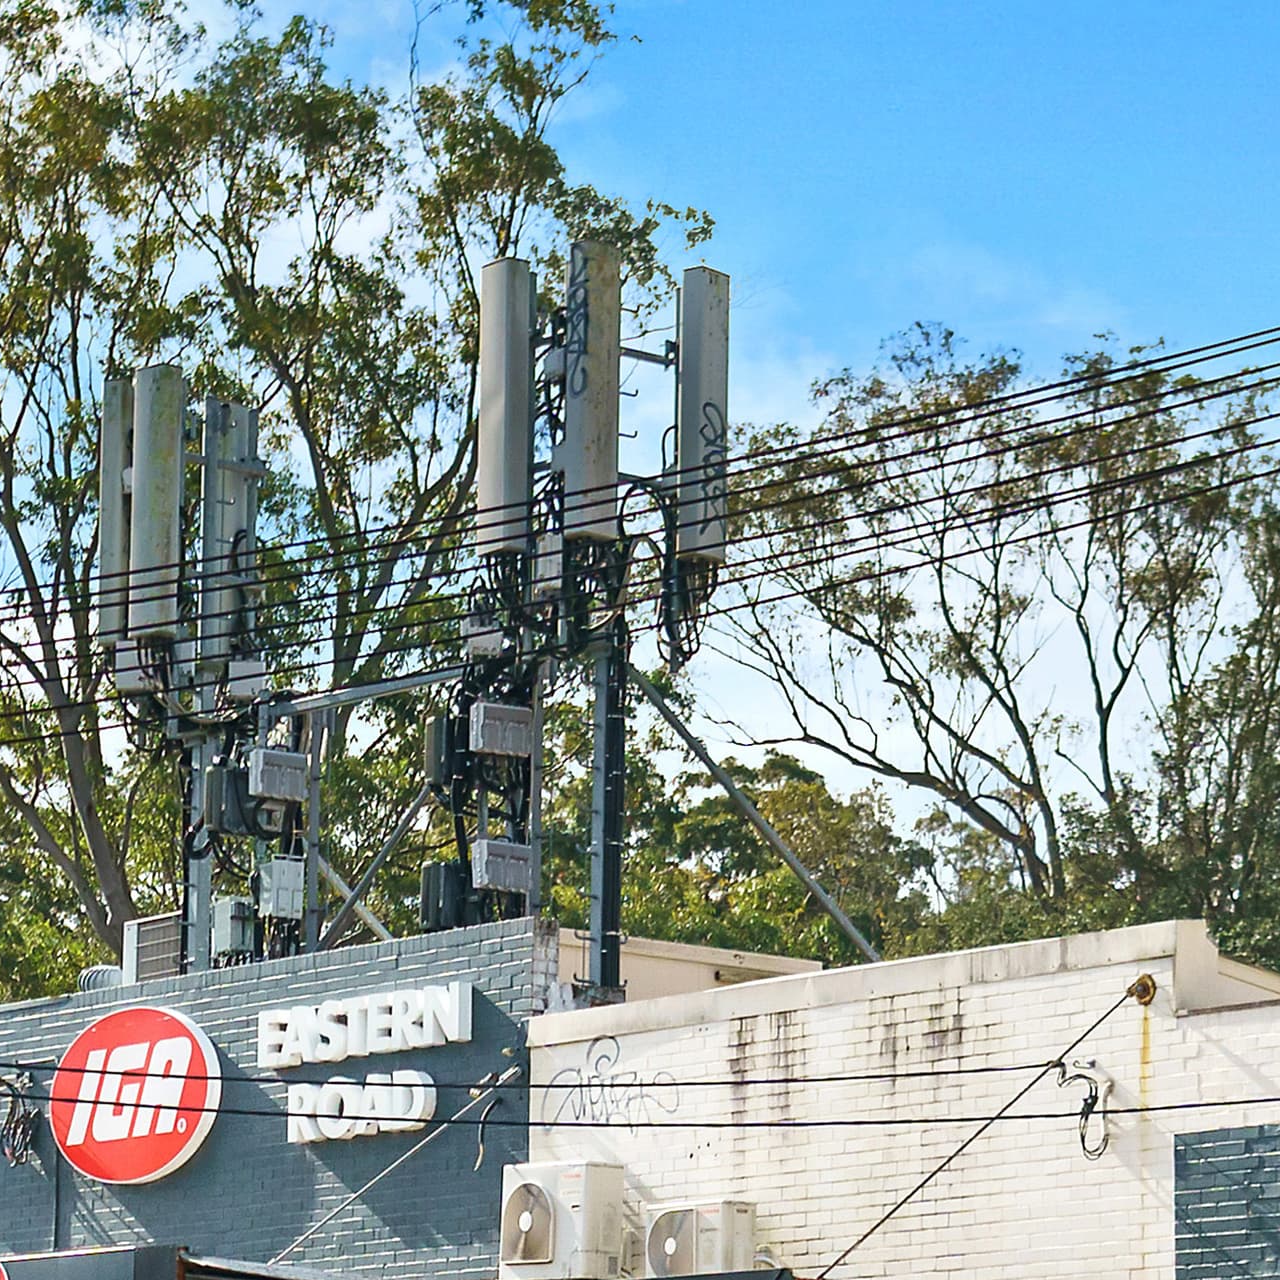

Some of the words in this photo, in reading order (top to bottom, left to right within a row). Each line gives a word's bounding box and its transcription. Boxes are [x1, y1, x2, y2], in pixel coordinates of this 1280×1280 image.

[258, 981, 472, 1068] EASTERN
[66, 1036, 192, 1146] IGA
[288, 1070, 437, 1143] ROAD
